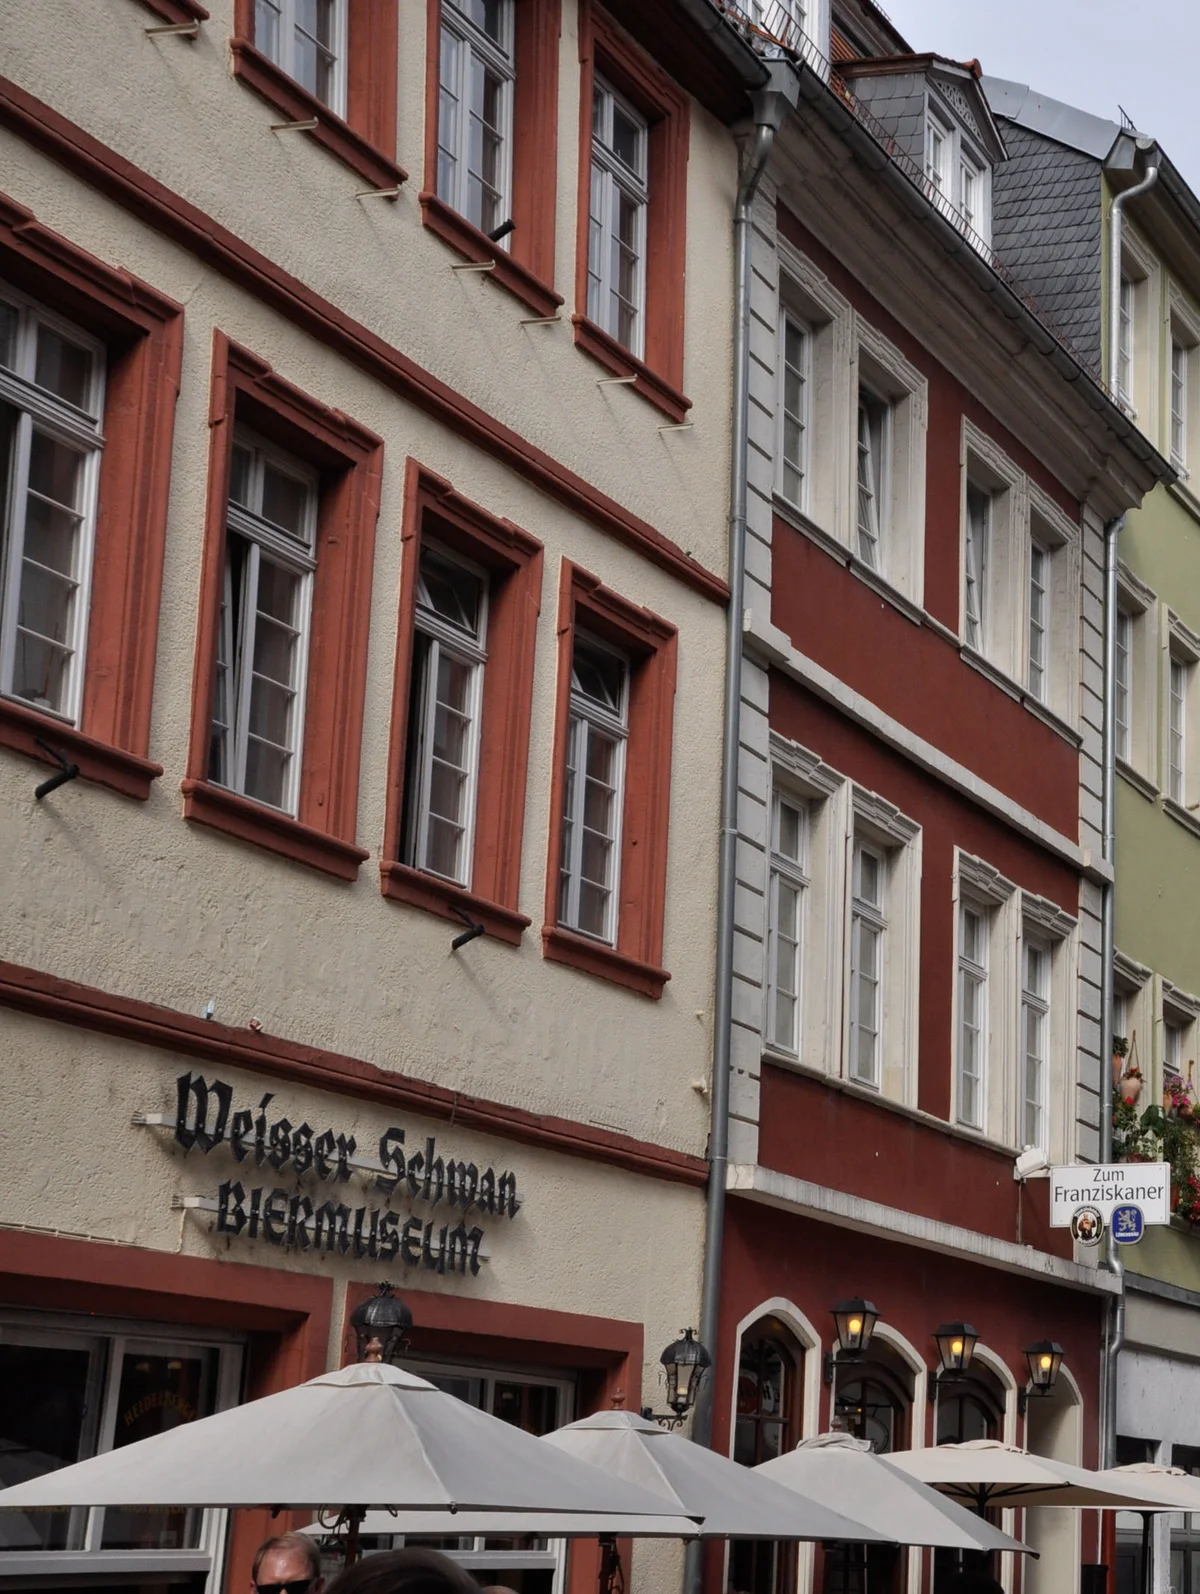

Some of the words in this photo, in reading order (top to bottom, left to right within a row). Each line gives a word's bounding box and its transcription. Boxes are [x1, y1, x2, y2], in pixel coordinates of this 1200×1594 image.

[175, 1070, 357, 1183] Weisser
[375, 1126, 521, 1220] Schwan
[1054, 1183, 1164, 1202] Franziskaner
[1093, 1168, 1125, 1182] Zum
[217, 1179, 484, 1277] BIERMUSEUM
